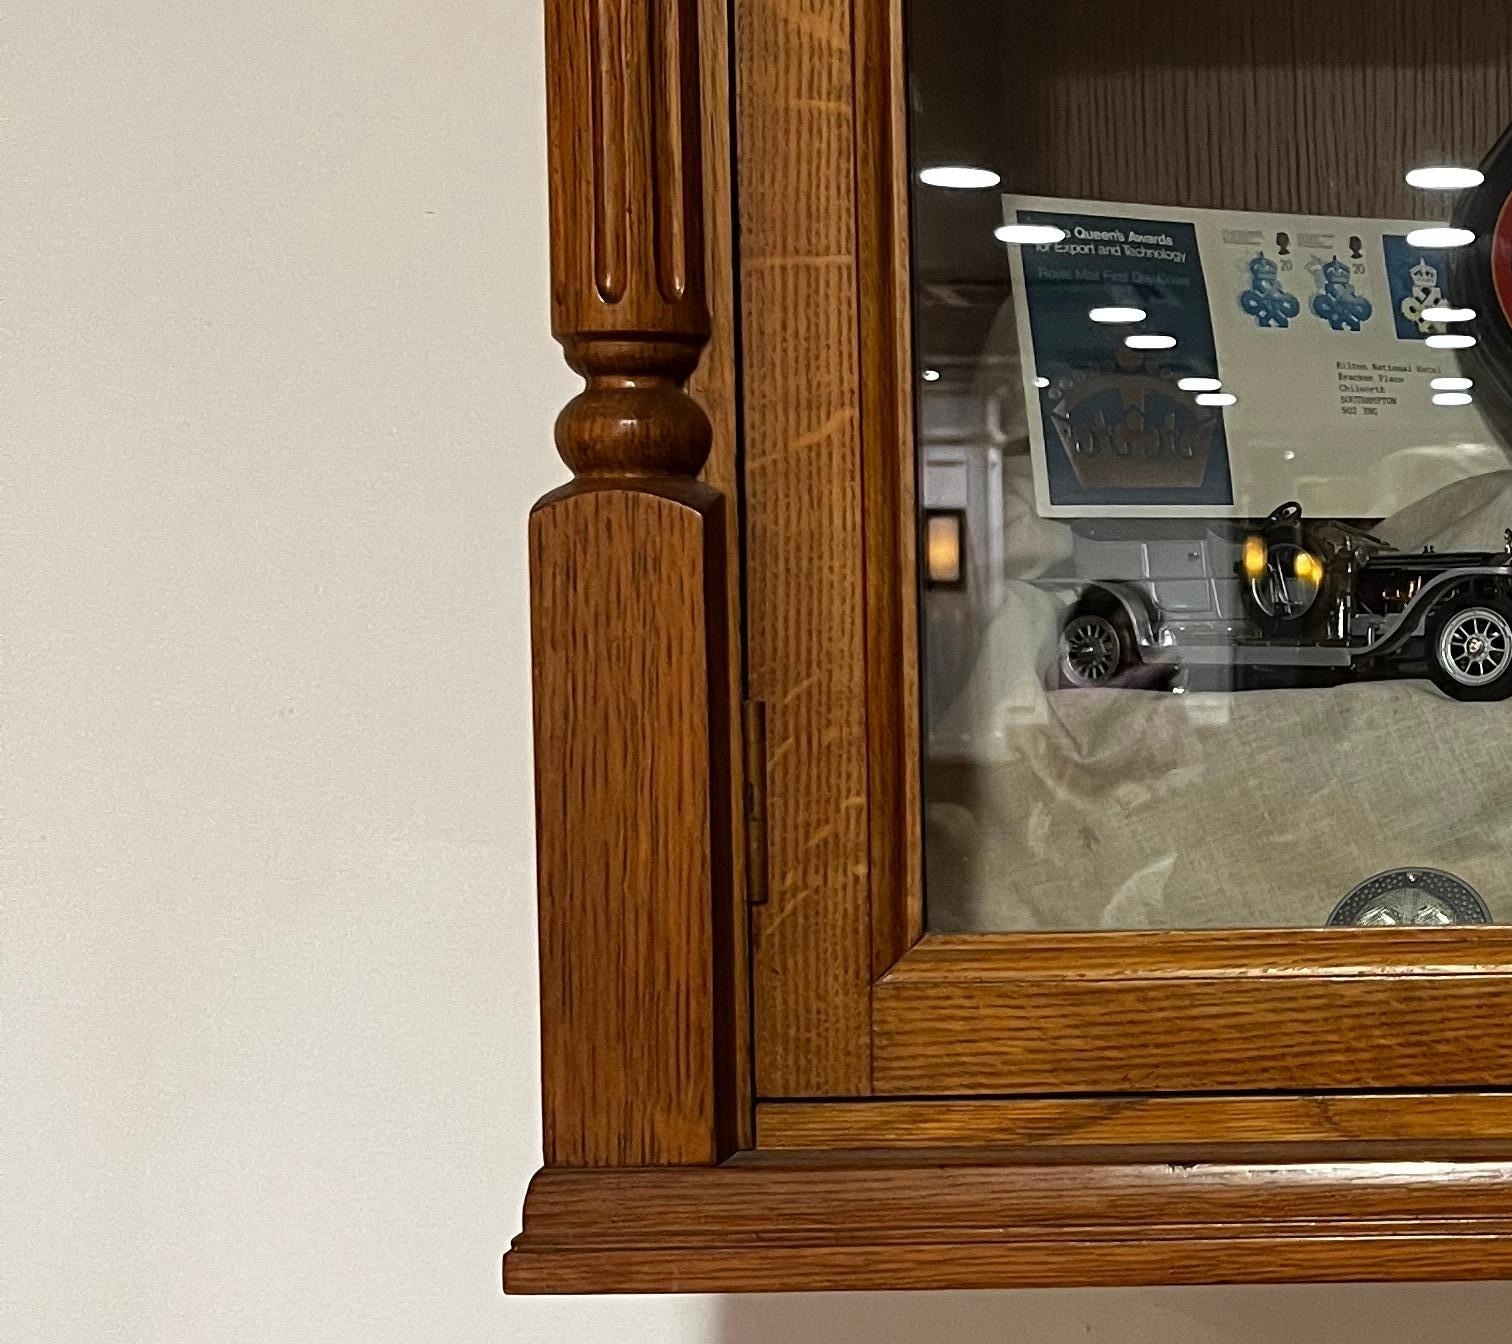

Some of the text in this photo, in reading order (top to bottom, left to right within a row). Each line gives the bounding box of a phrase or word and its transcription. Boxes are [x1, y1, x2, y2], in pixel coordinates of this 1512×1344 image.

[1073, 226, 1126, 243] Queen's
[1128, 230, 1174, 246] Awards
[1055, 244, 1096, 255] Export
[1098, 244, 1121, 257] and
[1123, 243, 1187, 264] Technology
[1352, 263, 1366, 275] 20
